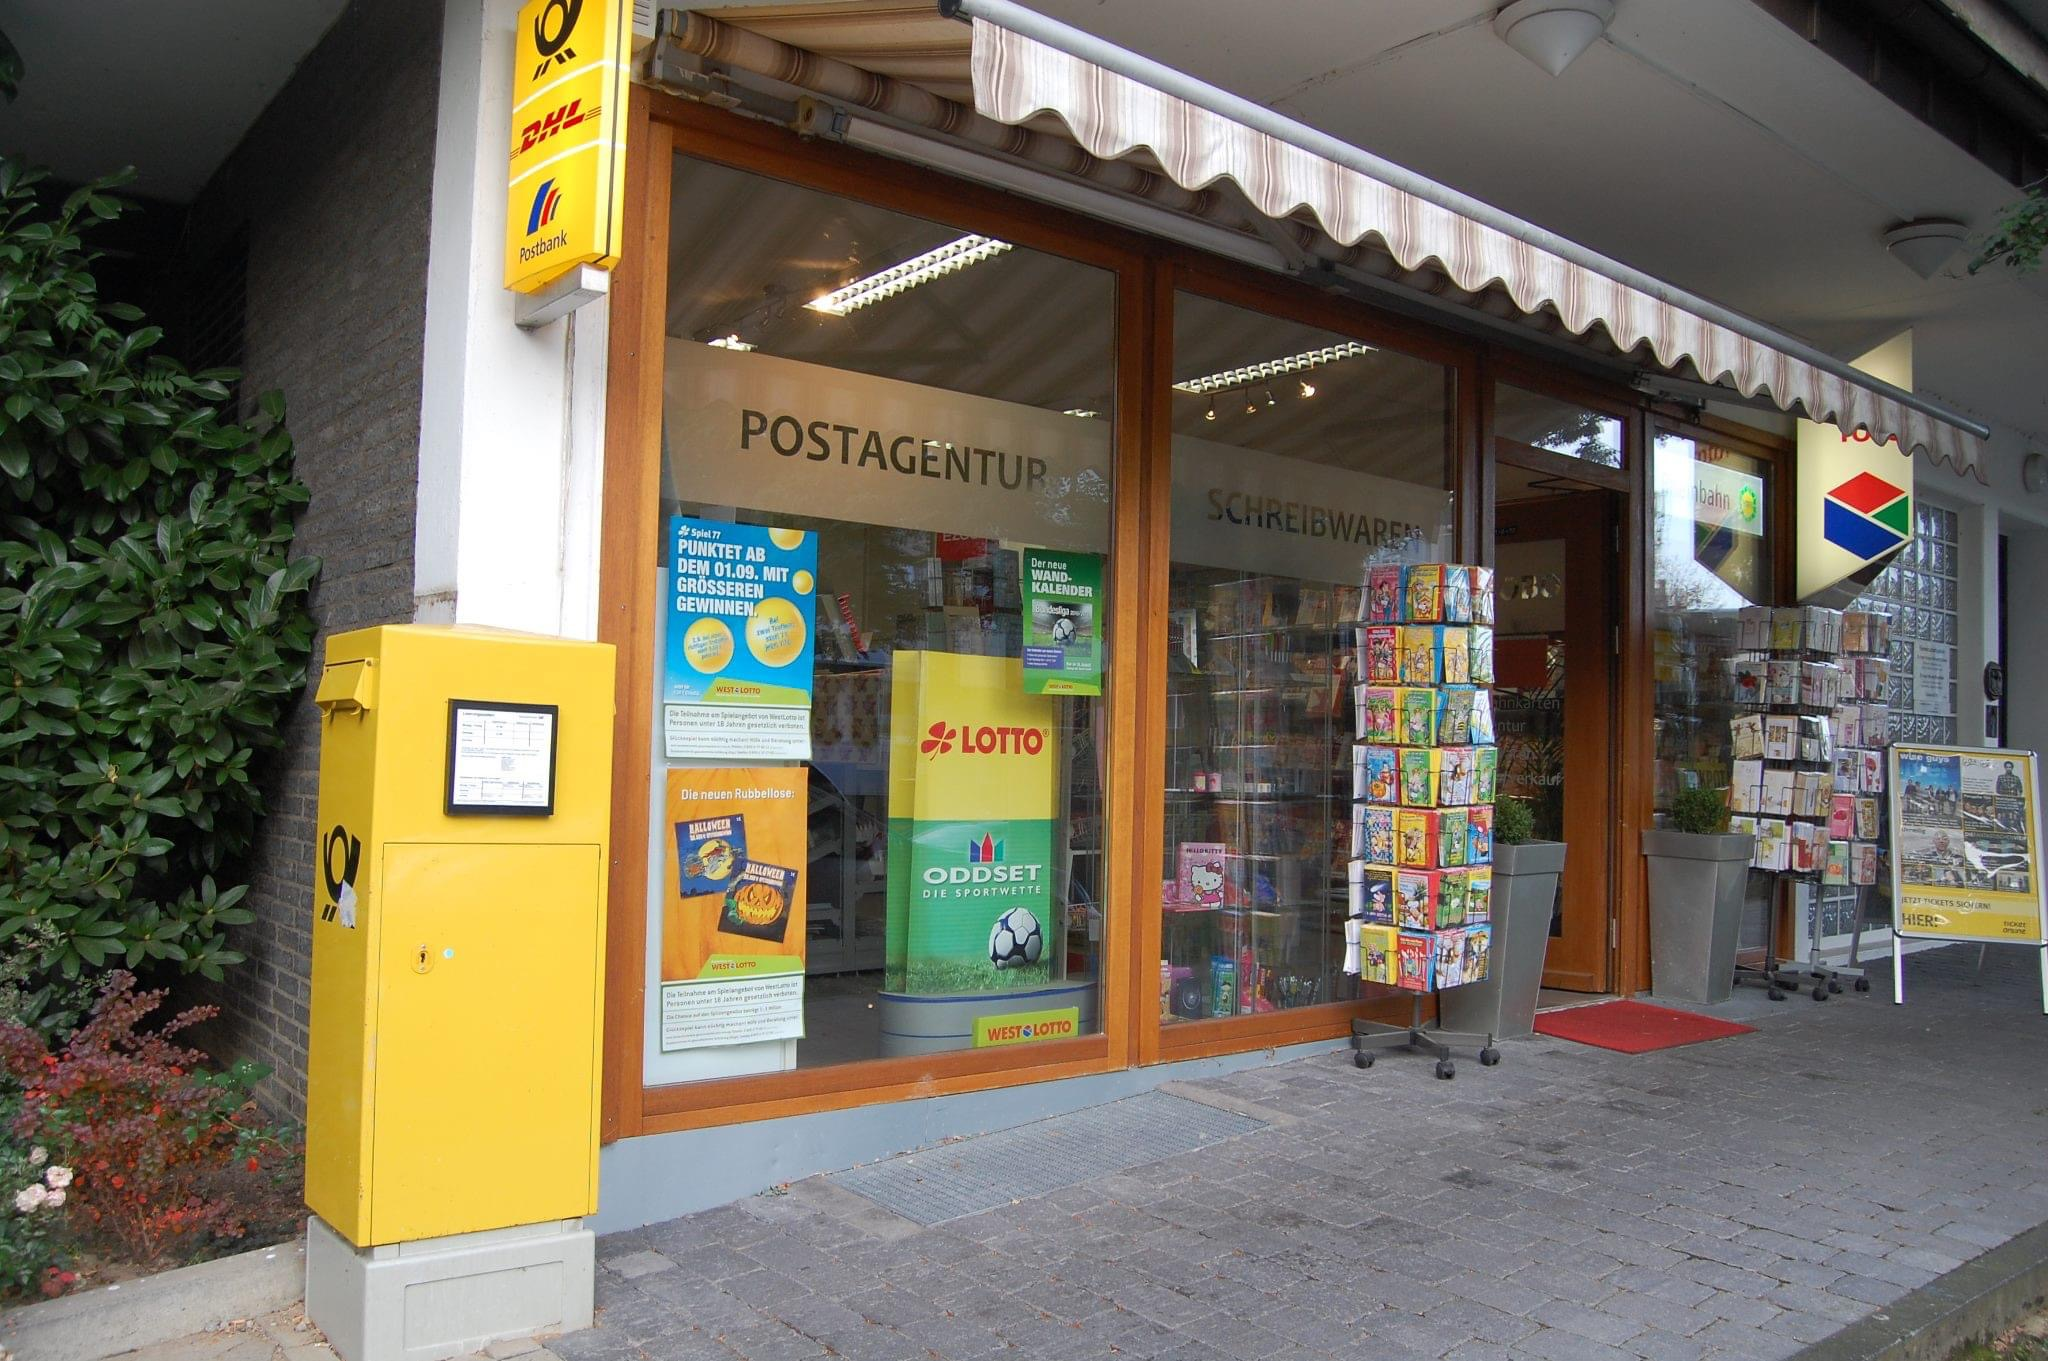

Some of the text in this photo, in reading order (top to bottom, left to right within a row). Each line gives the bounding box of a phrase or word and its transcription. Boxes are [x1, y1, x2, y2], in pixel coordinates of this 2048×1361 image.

[519, 98, 585, 154] DHL
[519, 229, 568, 265] Postbank
[741, 409, 1048, 491] POSTAGENTUR
[691, 528, 722, 540] Spiel 77
[678, 539, 766, 562] PUNKTET AB
[678, 558, 790, 583] DEM 01.09. MIT
[1032, 558, 1067, 570] Der neue
[1032, 569, 1072, 583] WAND-
[677, 576, 764, 599] GRÖSSEREN
[1032, 582, 1092, 598] KALENDER
[676, 596, 758, 618] GEWINNEN.
[1498, 694, 1560, 710] hnkarten
[1498, 719, 1528, 732] ntur
[962, 726, 1043, 755] LOTTO
[1926, 755, 1950, 764] guys
[1516, 772, 1562, 786] erkauf
[682, 788, 795, 800] Die neuen Rubbellose:
[689, 818, 730, 834] HALLOWEEN
[746, 862, 785, 880] HALLOWEEN
[923, 864, 1042, 885] ODDSET
[923, 885, 1042, 898] DIE SPORTWETTE
[1924, 898, 1954, 907] TICKETS
[988, 1020, 1072, 1041] WEST LOTTO
